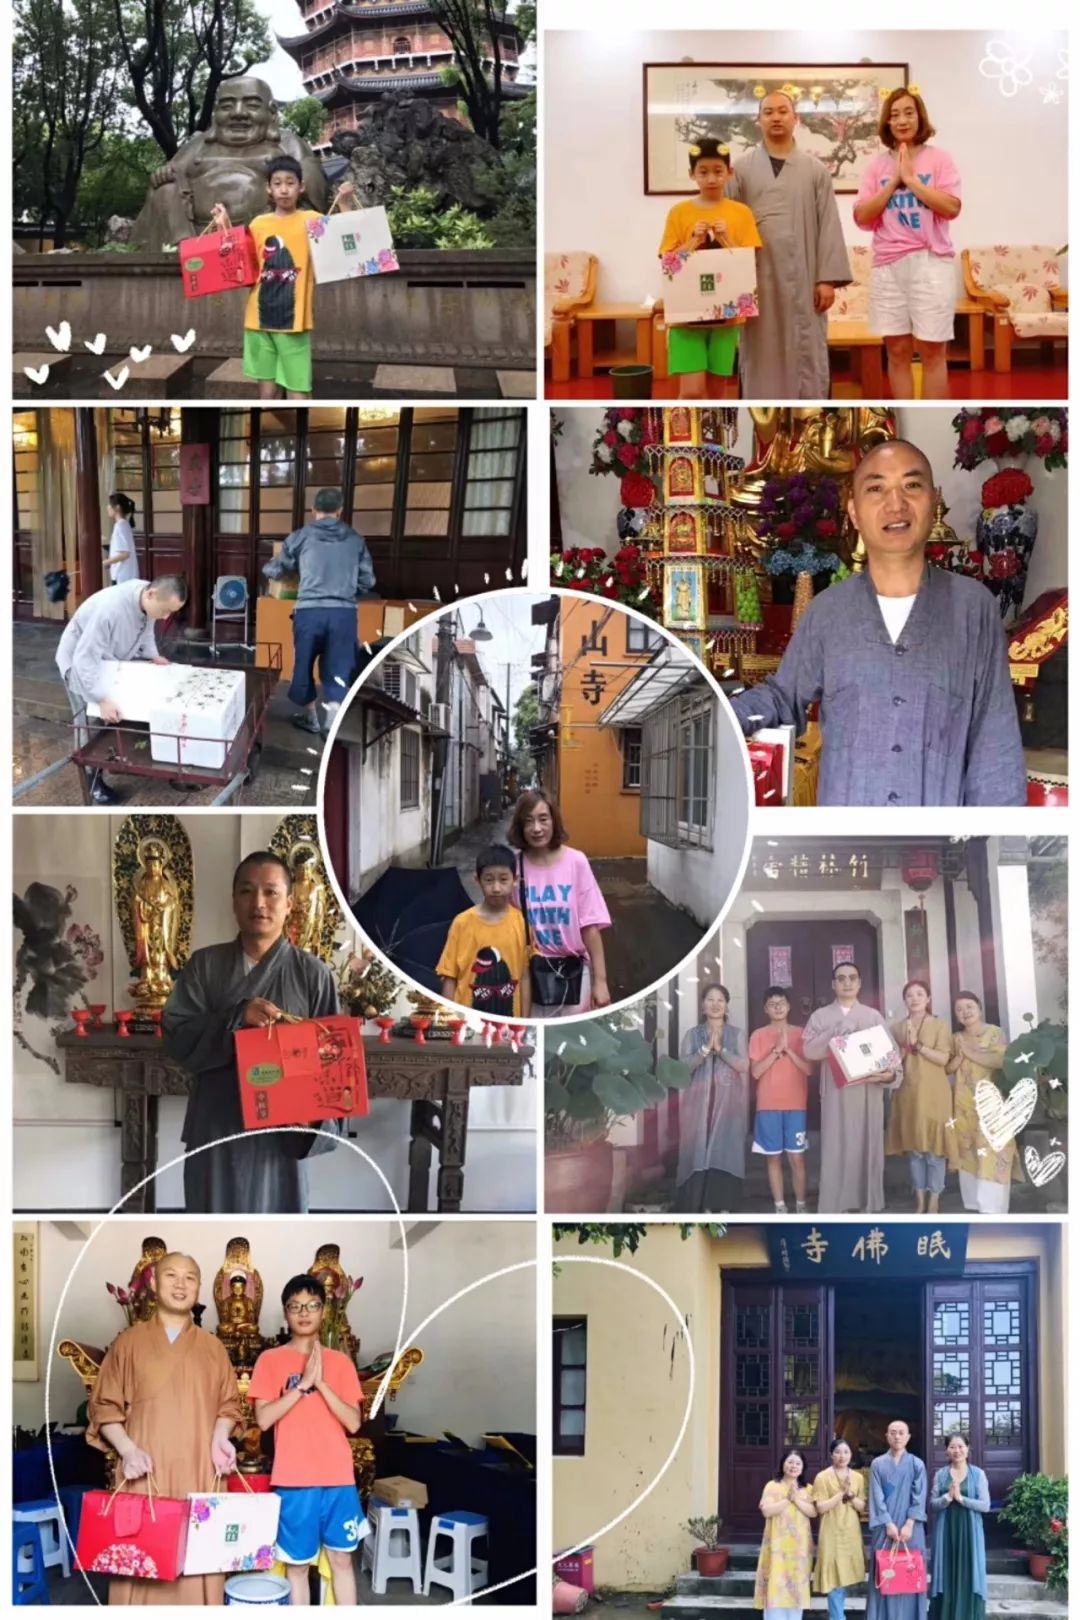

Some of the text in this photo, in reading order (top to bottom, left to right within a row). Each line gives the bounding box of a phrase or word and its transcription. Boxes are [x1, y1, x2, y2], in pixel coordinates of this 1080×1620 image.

[581, 619, 607, 706] 山寺
[525, 884, 573, 903] LAY
[801, 1226, 952, 1265] 眠佛寺
